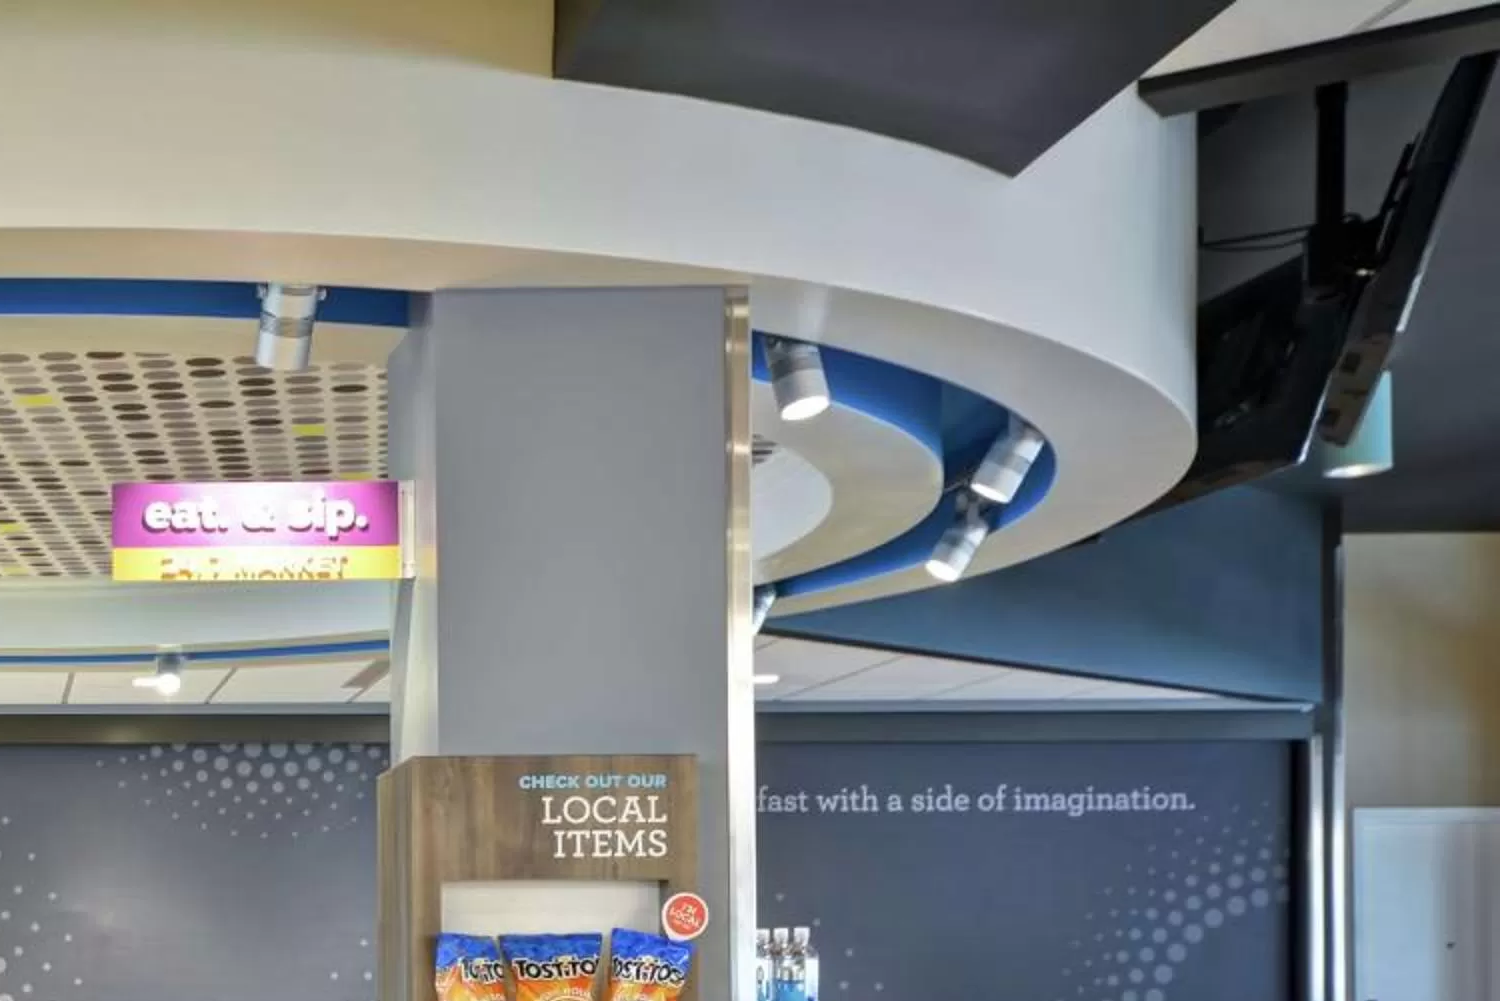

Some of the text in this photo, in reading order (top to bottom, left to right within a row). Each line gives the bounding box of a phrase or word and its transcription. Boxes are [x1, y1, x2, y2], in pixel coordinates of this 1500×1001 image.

[519, 774, 667, 790] CHECK OUT OUR
[541, 795, 668, 824] LOCAL
[816, 786, 878, 812] with
[886, 793, 902, 812] a
[911, 785, 969, 812] side
[977, 785, 1007, 812] of
[1013, 785, 1196, 817] imagination.
[553, 829, 668, 858] ITEMS
[515, 956, 599, 979] TOSTITO
